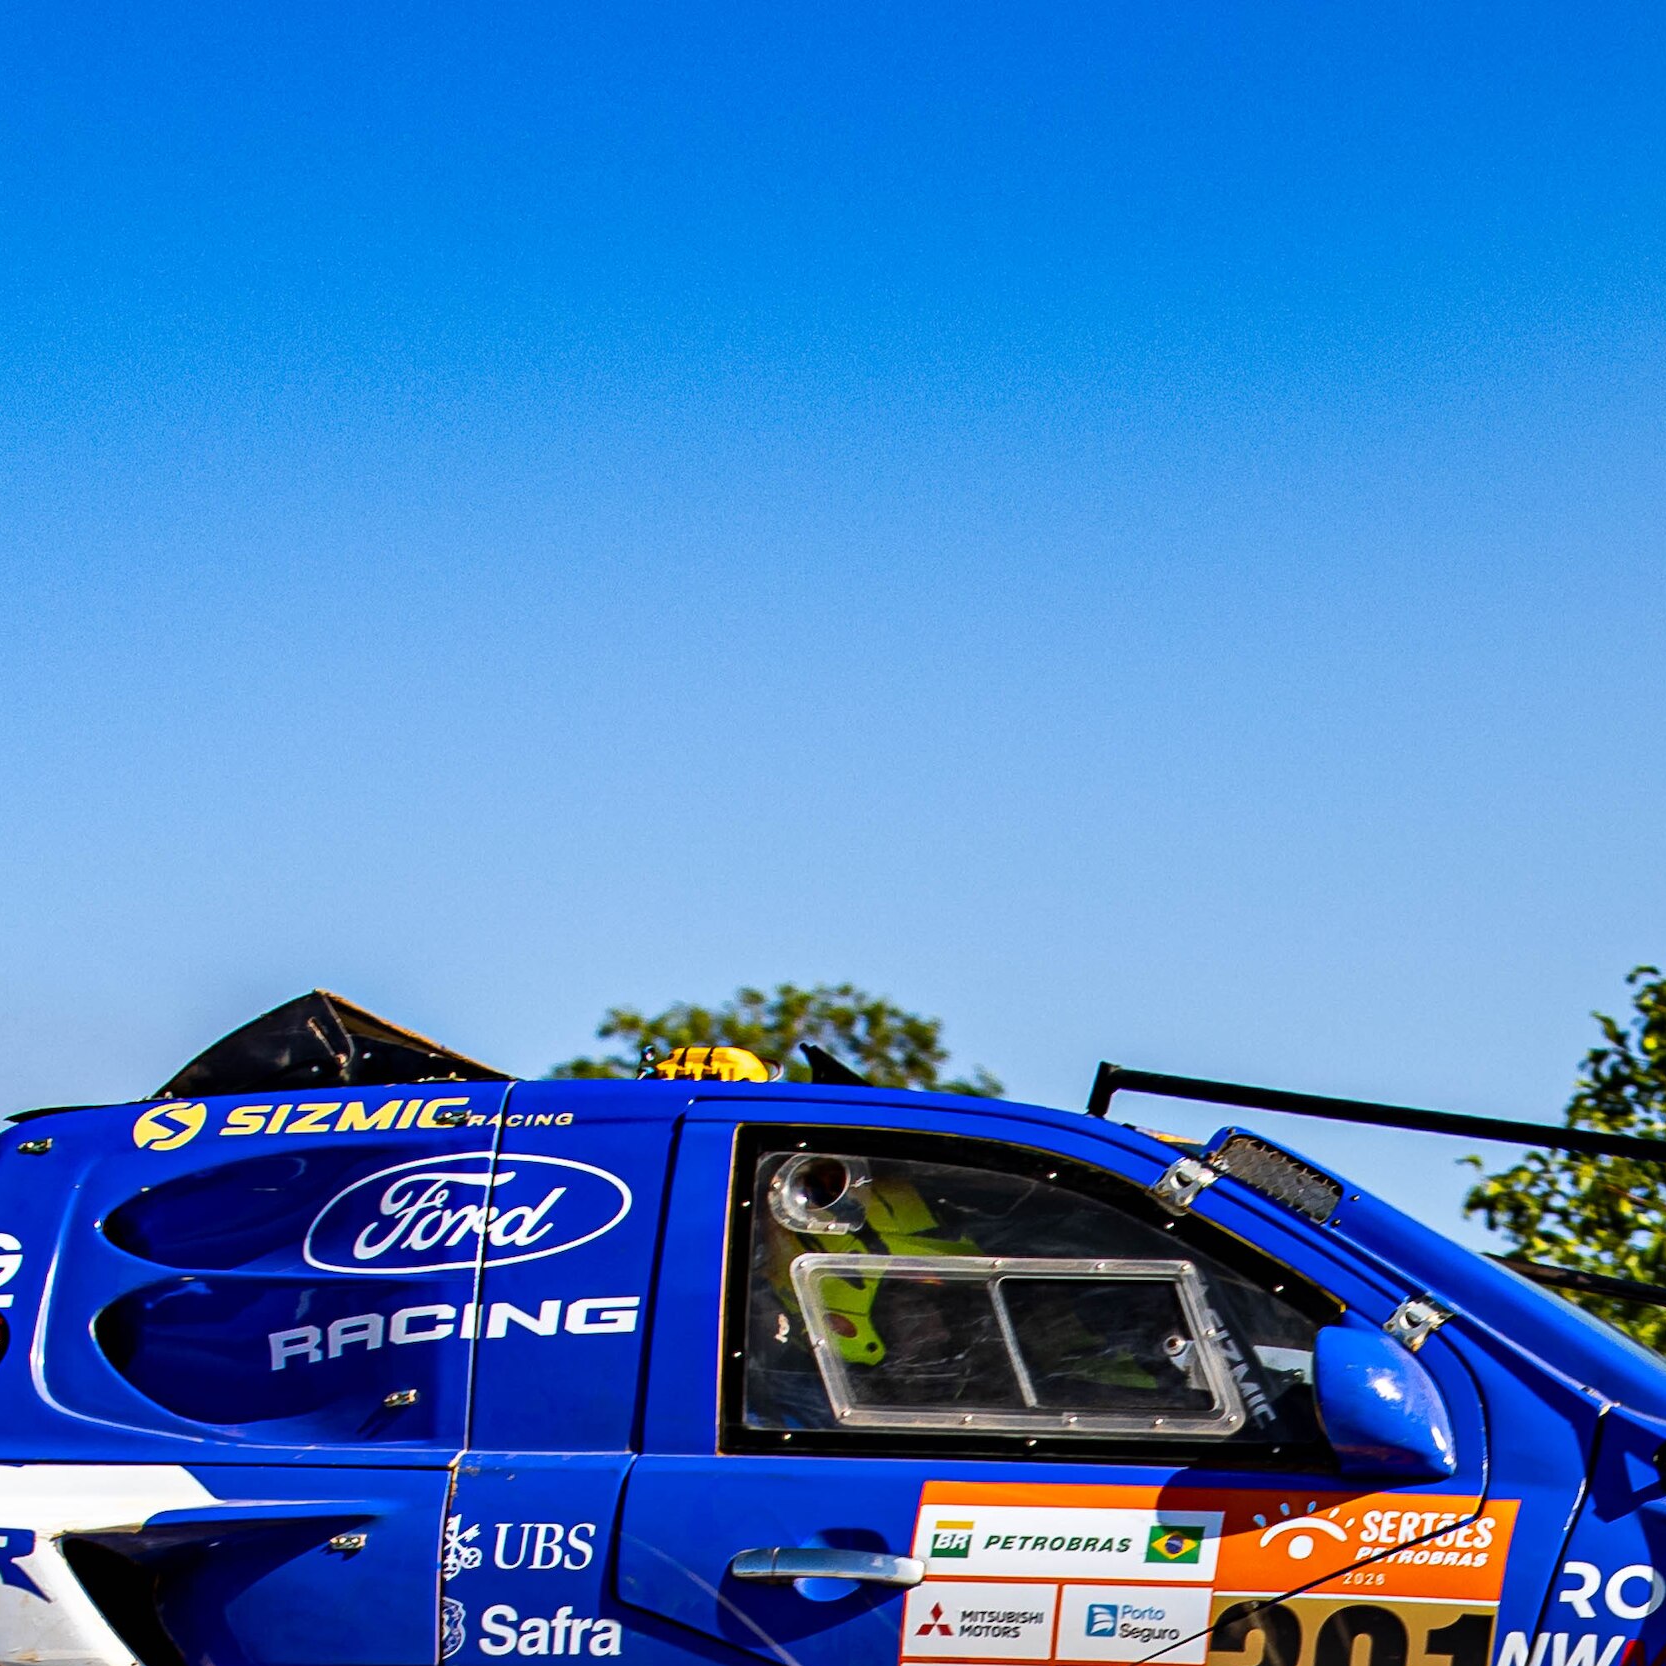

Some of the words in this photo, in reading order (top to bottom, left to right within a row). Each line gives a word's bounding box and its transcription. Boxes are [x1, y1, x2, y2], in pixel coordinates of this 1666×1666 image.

[219, 1097, 470, 1136] SIZMIC
[466, 1112, 575, 1128] RACING
[352, 1170, 567, 1260] Ford
[268, 1296, 641, 1371] RACING
[493, 1521, 596, 1571] UBS
[933, 1533, 970, 1551] BR
[983, 1534, 1132, 1553] PETROBRAS
[959, 1609, 1045, 1625] MITSUBISHI
[1121, 1604, 1166, 1621] Porto
[478, 1603, 622, 1657] Safra
[959, 1625, 1022, 1639] MOTORS
[1119, 1622, 1180, 1644] Seguro
